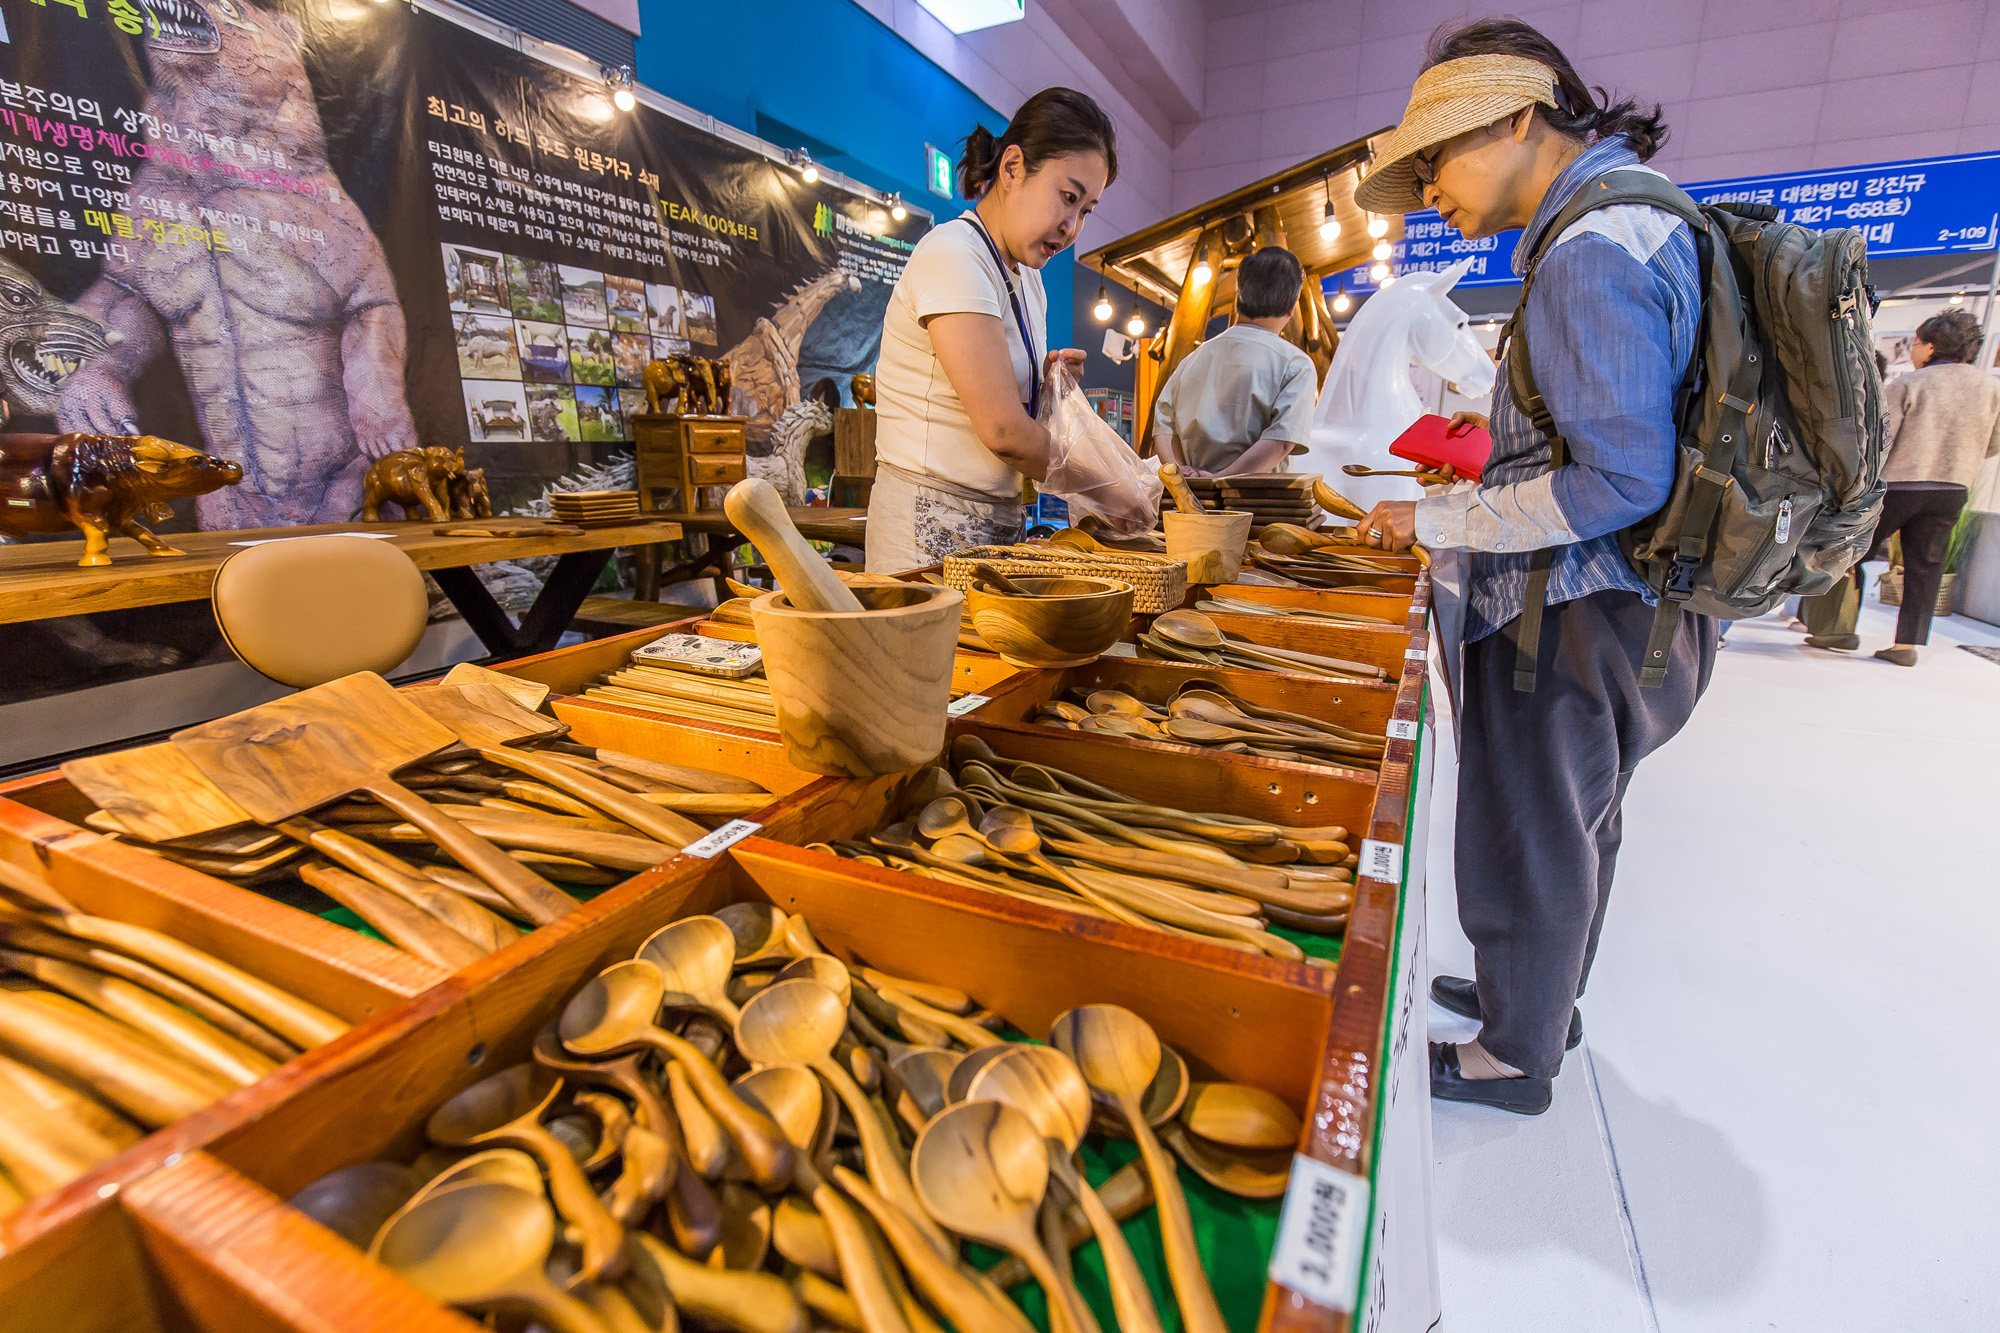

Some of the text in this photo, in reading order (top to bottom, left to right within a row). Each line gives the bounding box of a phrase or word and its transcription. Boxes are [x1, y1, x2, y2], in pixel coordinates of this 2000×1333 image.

[0, 78, 104, 126] 본주의의
[113, 106, 181, 144] 상징인
[427, 95, 487, 135] 최고의
[536, 130, 569, 159] 우드
[574, 147, 632, 181] 원목가구
[638, 167, 660, 193] 소재
[92, 160, 132, 184] 인한
[428, 140, 485, 169] 티크원목은
[488, 157, 509, 177] 다른
[511, 165, 530, 182] 나무
[432, 162, 488, 189] 천연적으로
[491, 177, 521, 198] 개미나
[1780, 180, 1860, 204] 대한명인
[1865, 174, 1926, 199] 강진규
[0, 200, 77, 230] 작품들을
[70, 184, 131, 211] 다양한
[138, 195, 193, 222] 작품을
[198, 206, 263, 234] 제작하고
[435, 184, 481, 207] 인테리어
[485, 195, 515, 215] 소재로
[519, 204, 555, 225] 사용되고
[558, 213, 584, 232] 있으며
[660, 200, 701, 226] TEAK
[1791, 197, 1911, 224] 제21-658호)
[438, 205, 484, 228] 변화되기
[487, 215, 519, 235] 때문에
[524, 224, 553, 243] 최고의
[555, 230, 572, 247] 가구
[576, 236, 600, 253] 소재로
[1938, 227, 1987, 241] 2-109
[69, 239, 134, 263] 합니다.
[1410, 235, 1499, 257] 제21-658호)
